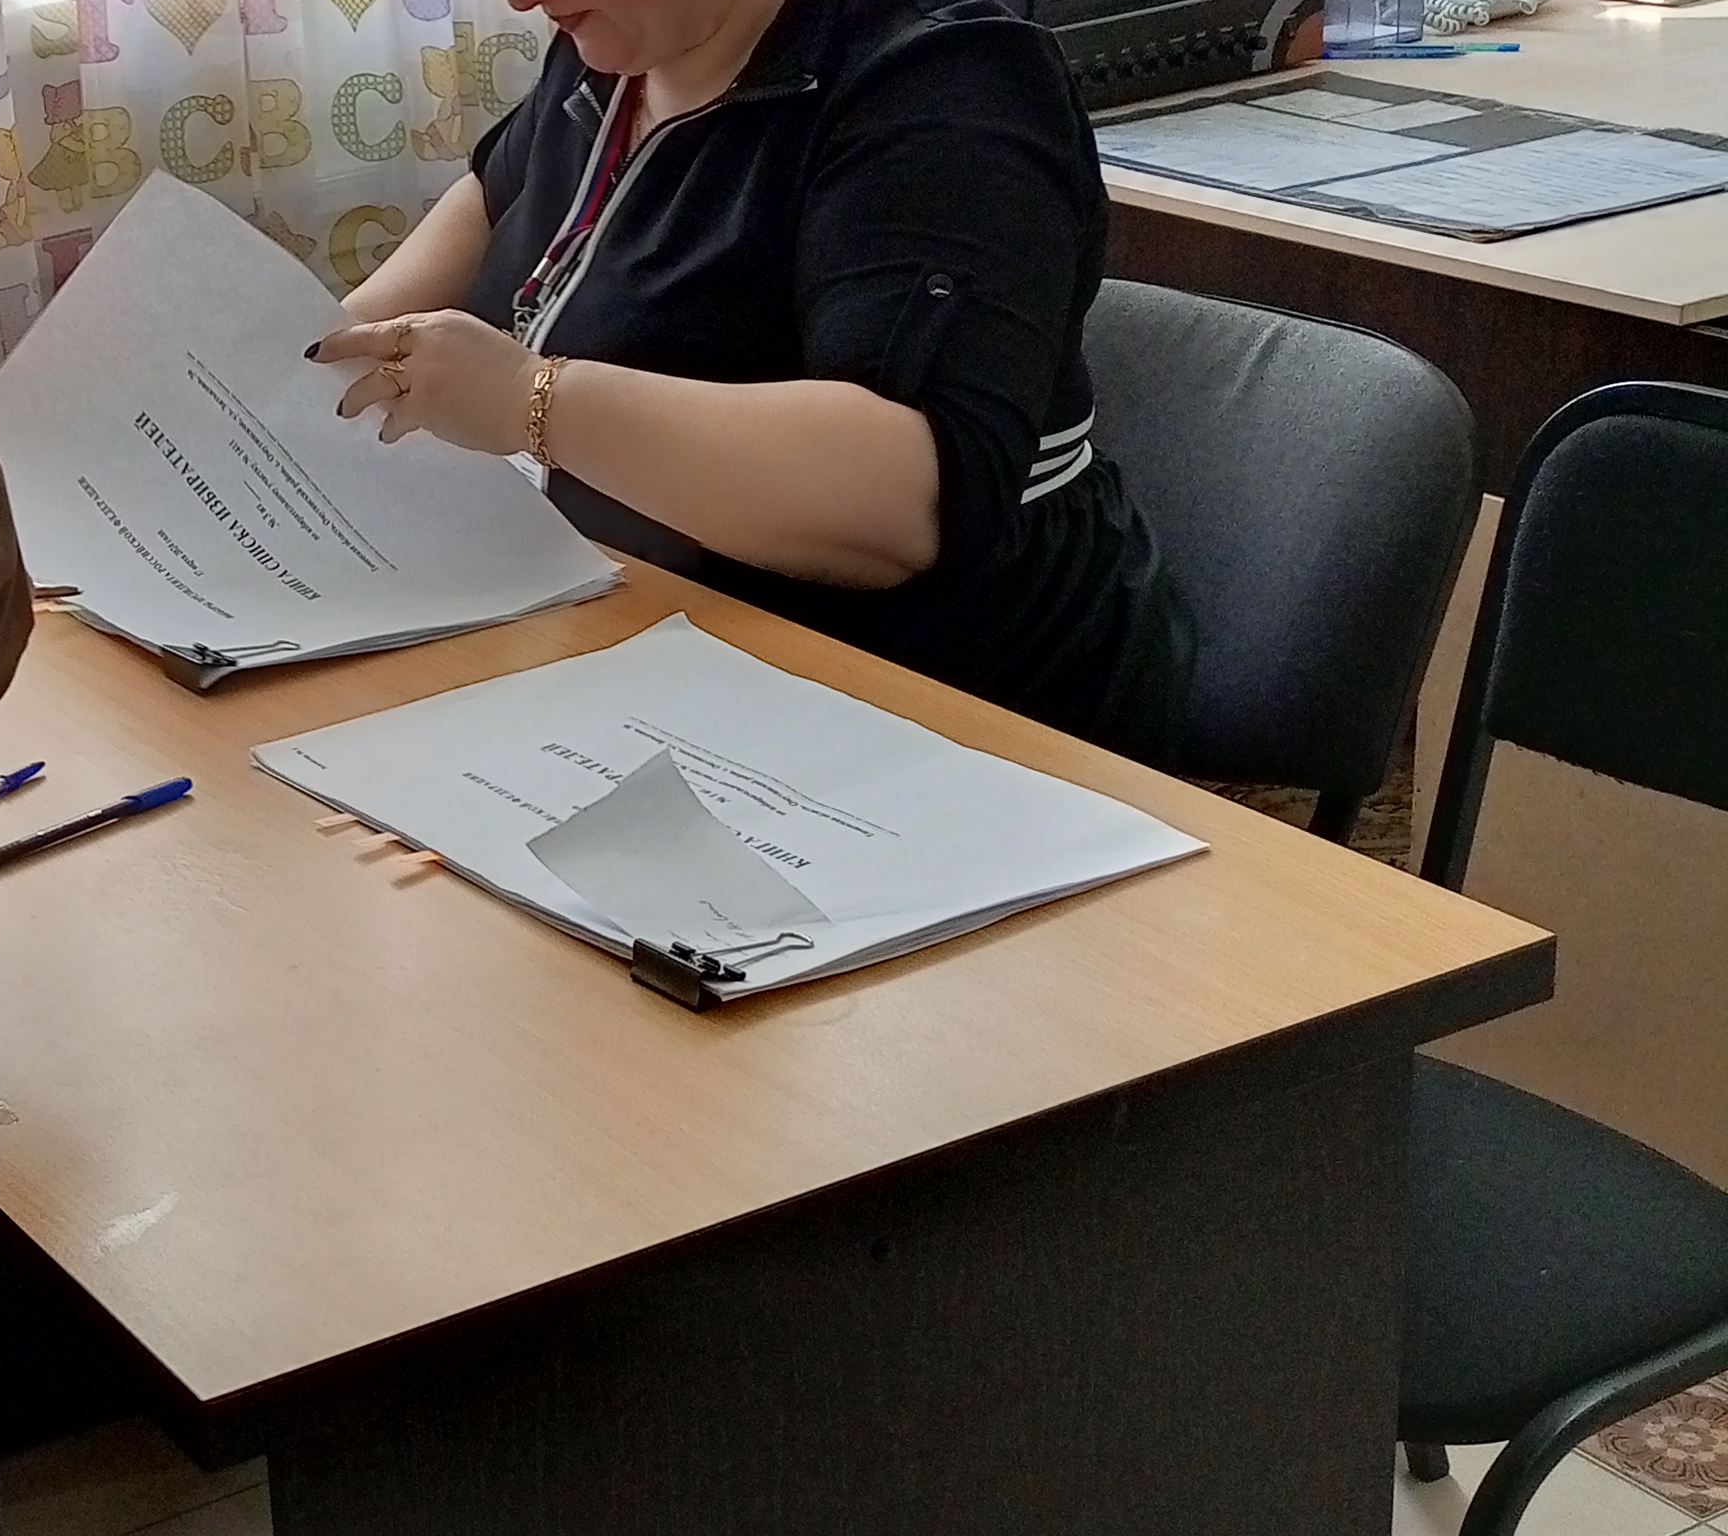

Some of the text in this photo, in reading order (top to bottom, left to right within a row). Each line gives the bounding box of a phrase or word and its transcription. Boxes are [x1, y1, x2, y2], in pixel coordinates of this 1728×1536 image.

[130, 408, 234, 524] ИЗБИРАТЕЛЕЙ
[226, 516, 282, 576] СПИСКА
[276, 567, 324, 603] КНИГА
[540, 743, 811, 869] КНИГА РАТЕЛЕЙ
